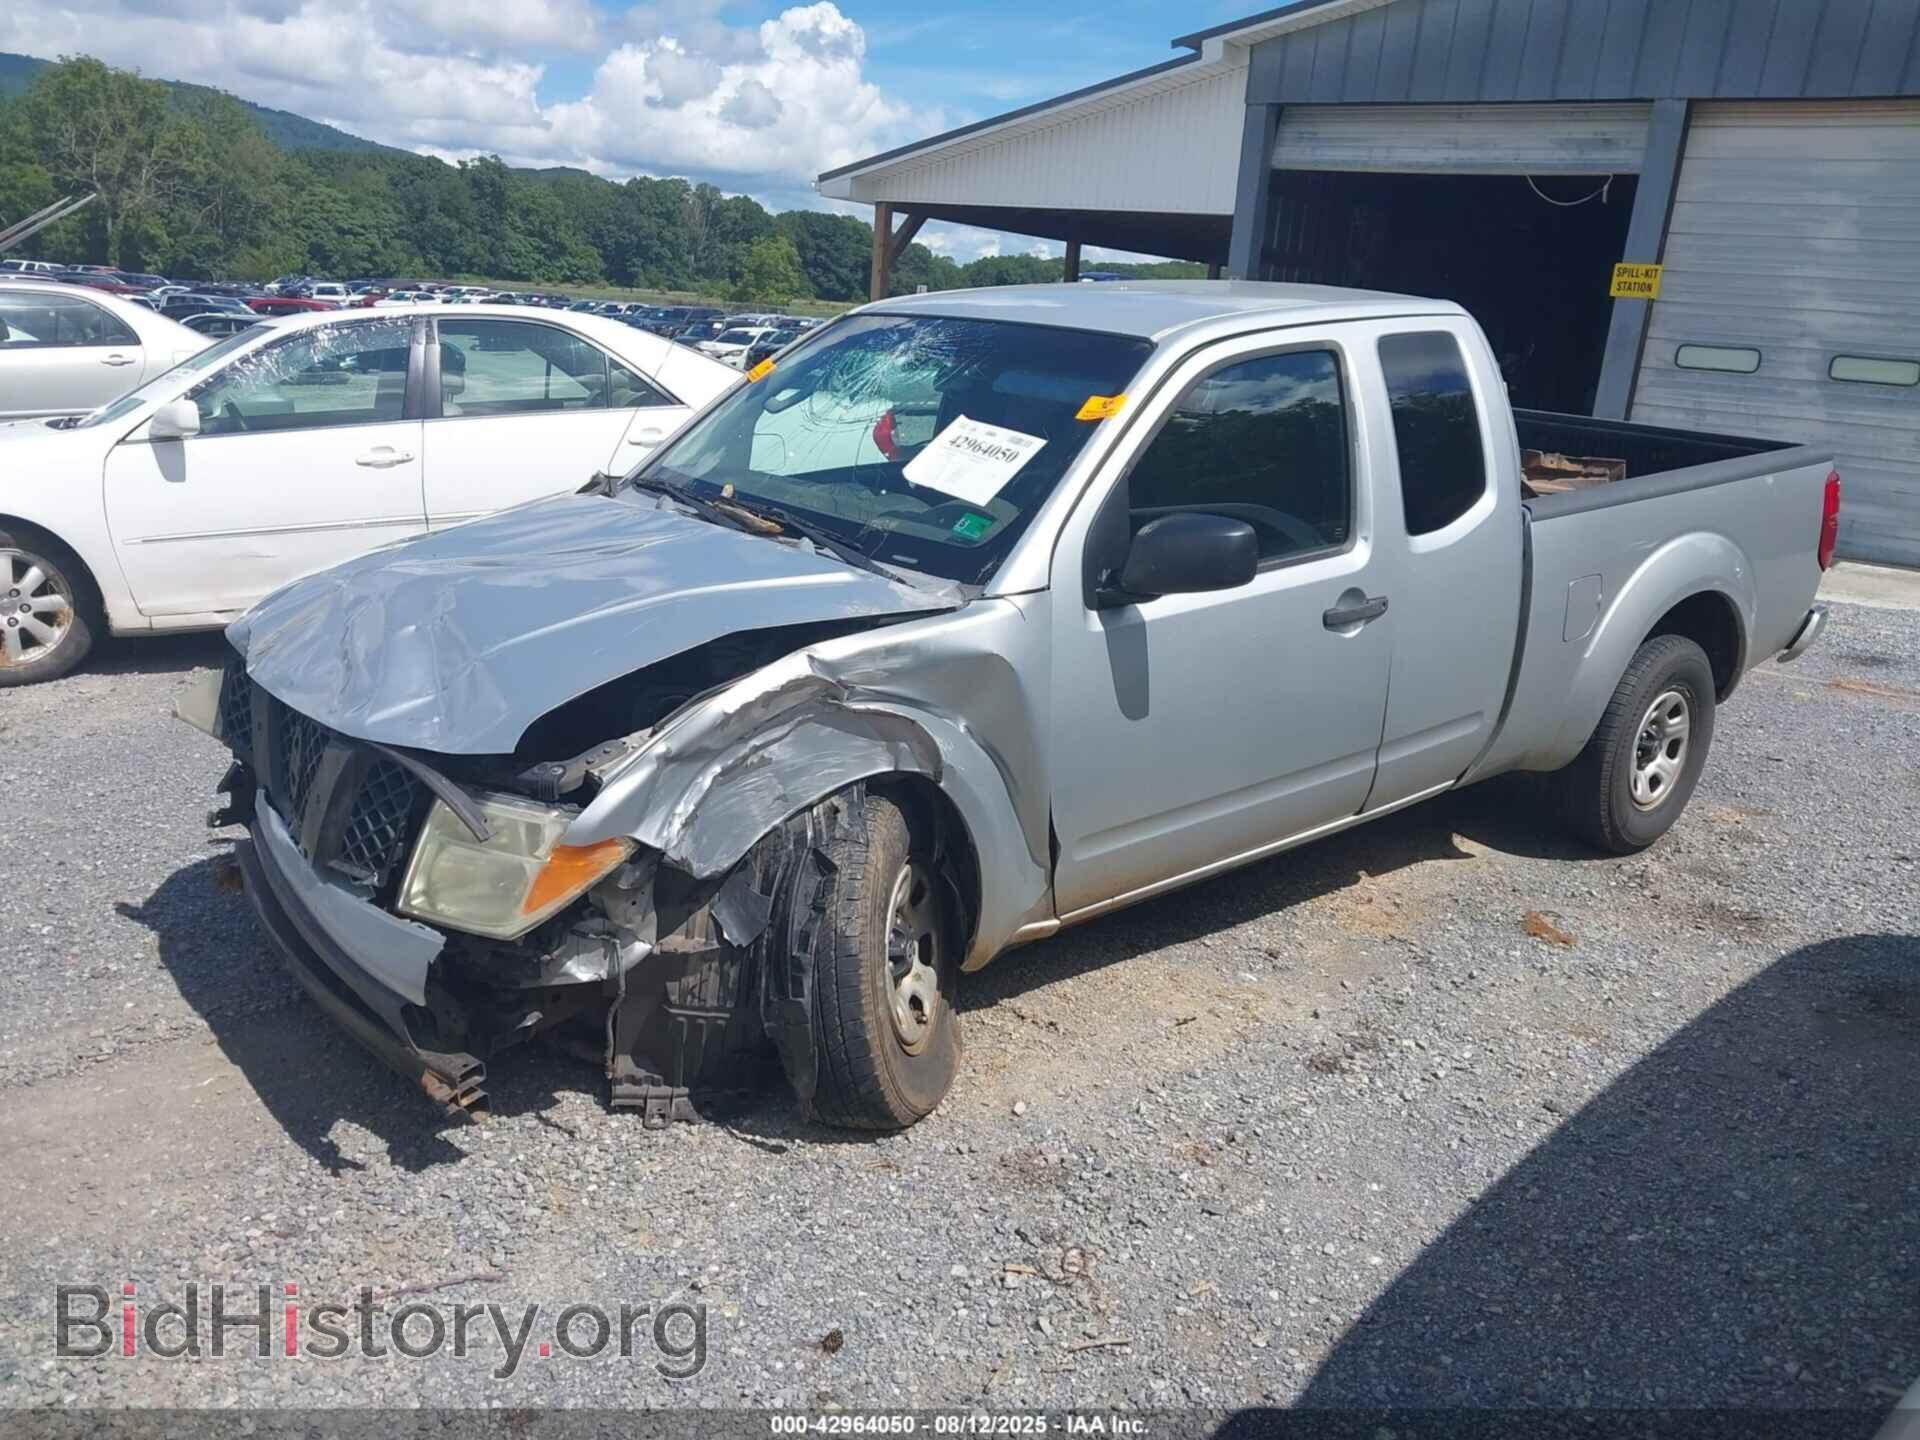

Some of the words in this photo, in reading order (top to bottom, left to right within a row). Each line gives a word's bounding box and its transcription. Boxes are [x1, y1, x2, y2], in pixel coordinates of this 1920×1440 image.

[1616, 266, 1659, 279] SPILL-KIT
[1616, 281, 1653, 293] STATION
[949, 434, 1020, 463] 42964050
